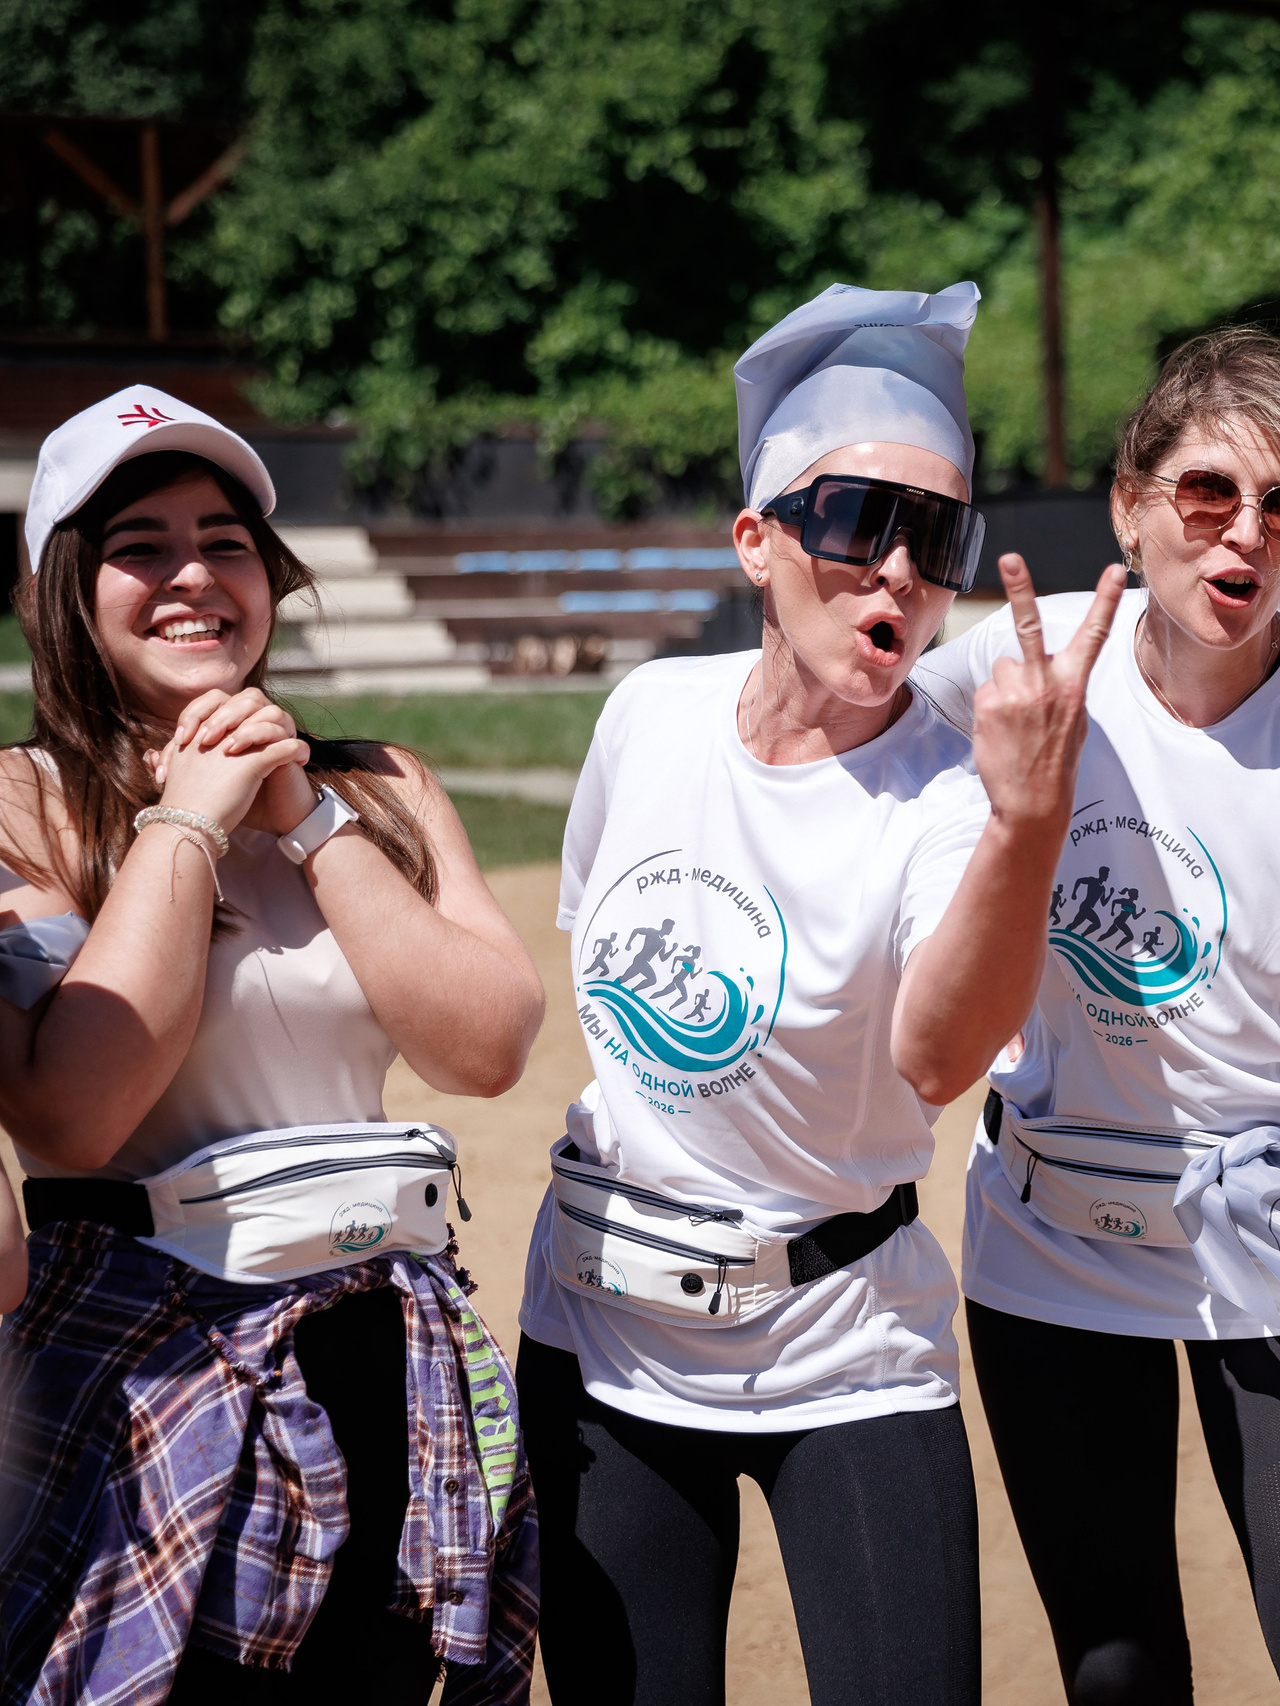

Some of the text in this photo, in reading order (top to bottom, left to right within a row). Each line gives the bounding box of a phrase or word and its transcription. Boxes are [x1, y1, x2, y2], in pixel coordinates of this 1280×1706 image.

[1086, 992, 1205, 1029] ОДНОЙ ВОЛНЕ
[577, 1003, 757, 1098] МЫ НА ОДНОЙ ВОЛНЕ
[1105, 1033, 1133, 1046] 2026
[647, 1096, 675, 1115] 2026
